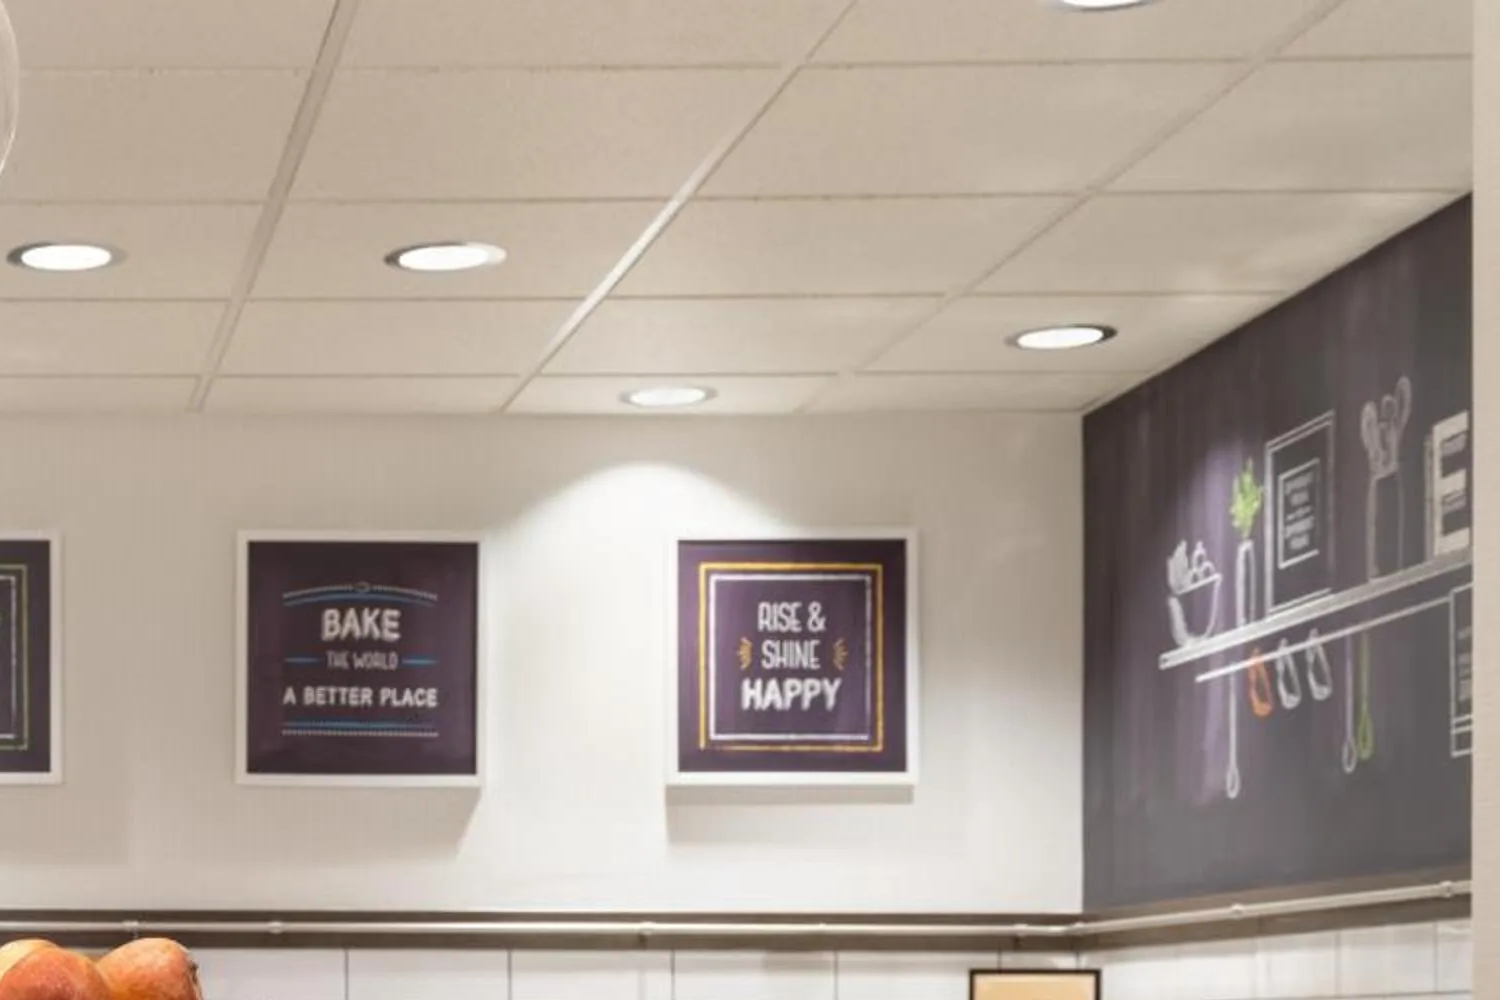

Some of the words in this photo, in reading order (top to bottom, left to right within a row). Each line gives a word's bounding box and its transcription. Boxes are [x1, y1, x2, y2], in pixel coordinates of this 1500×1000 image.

[322, 607, 401, 642] BAKE
[757, 601, 802, 633] RISE
[807, 601, 827, 632] &
[326, 651, 350, 669] THE
[353, 651, 399, 670] WORLD
[760, 639, 821, 670] SHINE
[282, 686, 297, 704] A
[303, 686, 373, 707] BETTER
[379, 687, 439, 708] PLACE
[740, 677, 842, 712] HAPPY
